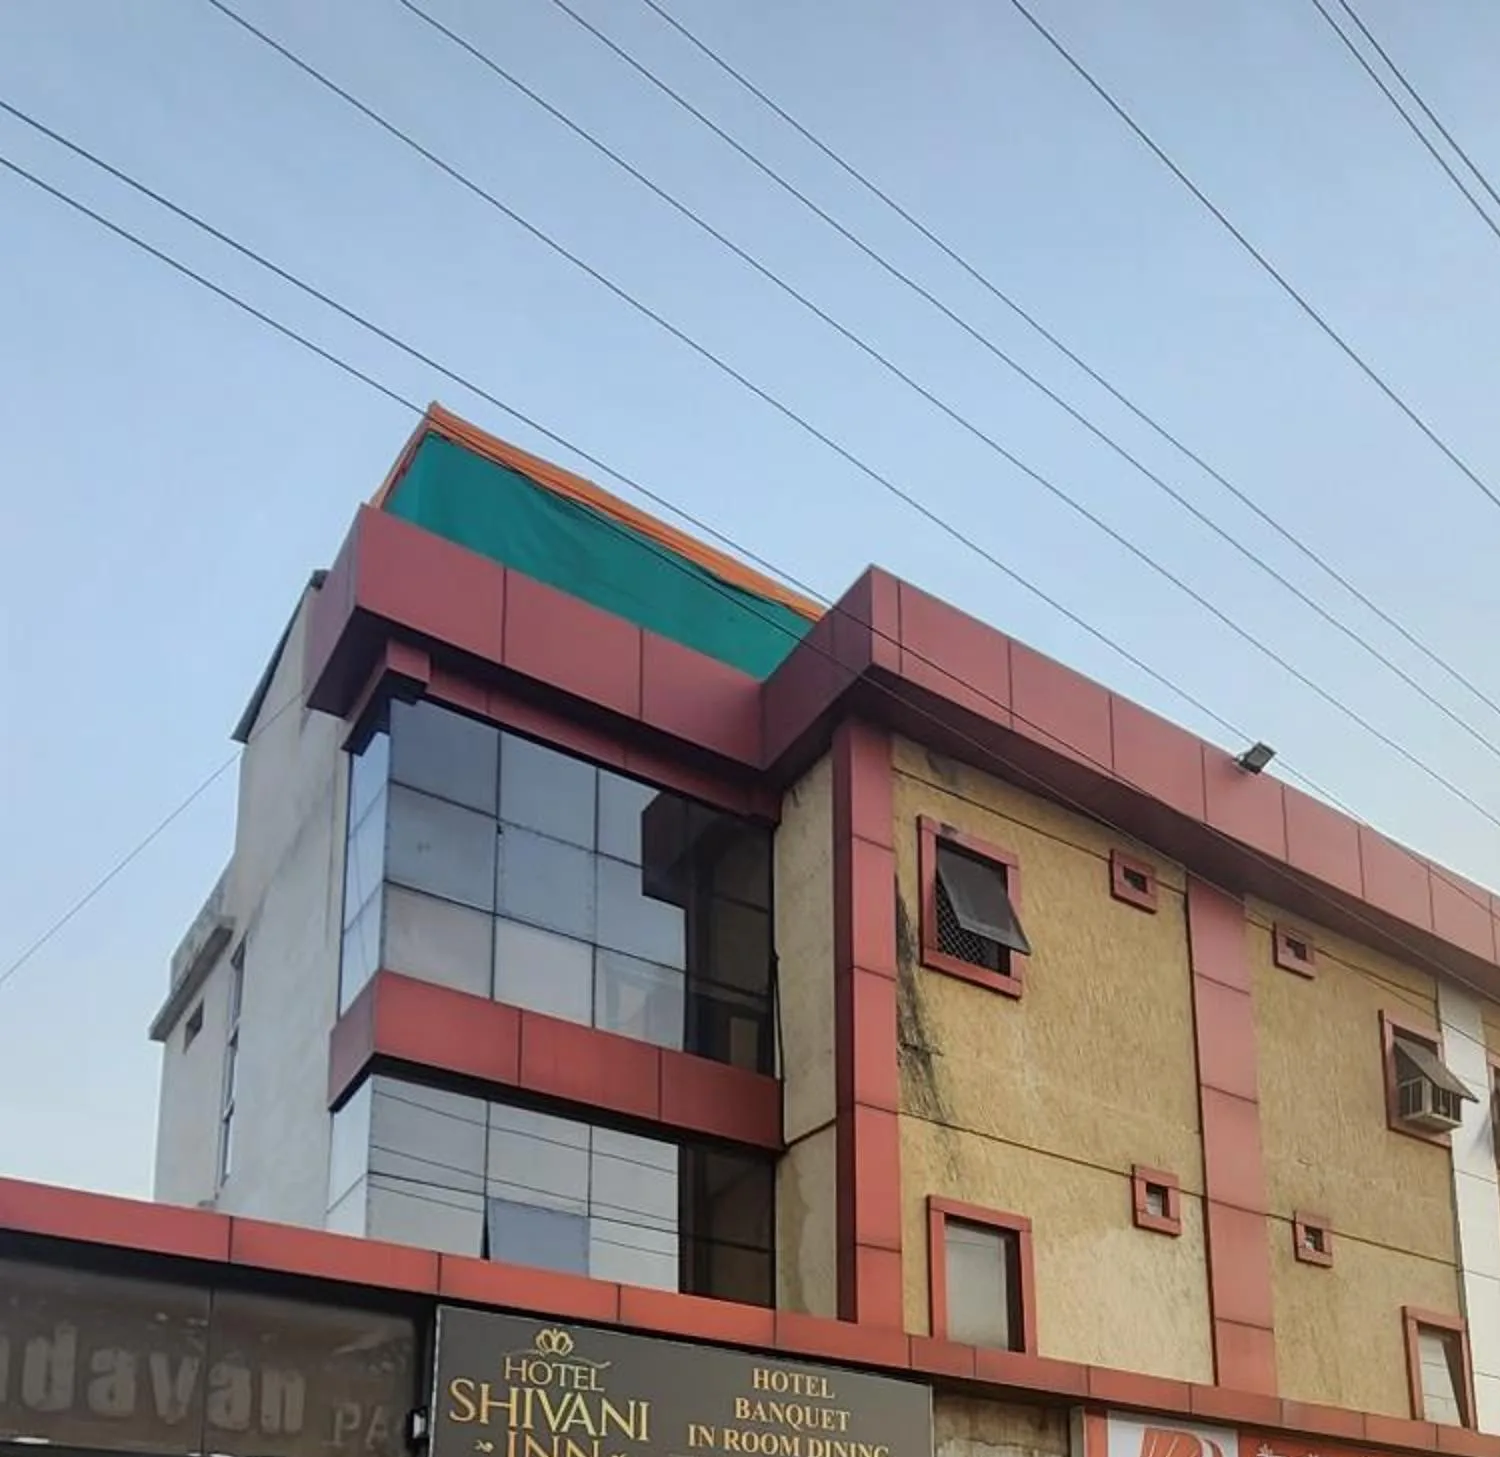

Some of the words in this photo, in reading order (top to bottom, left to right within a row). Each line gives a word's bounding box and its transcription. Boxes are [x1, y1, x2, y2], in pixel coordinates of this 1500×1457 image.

[504, 1356, 606, 1393] HOTEL
[752, 1367, 836, 1400] HOTEL
[449, 1377, 650, 1441] SHIVANI
[734, 1397, 851, 1433] BANQUET
[687, 1423, 716, 1449] IN
[723, 1428, 800, 1457] ROOM
